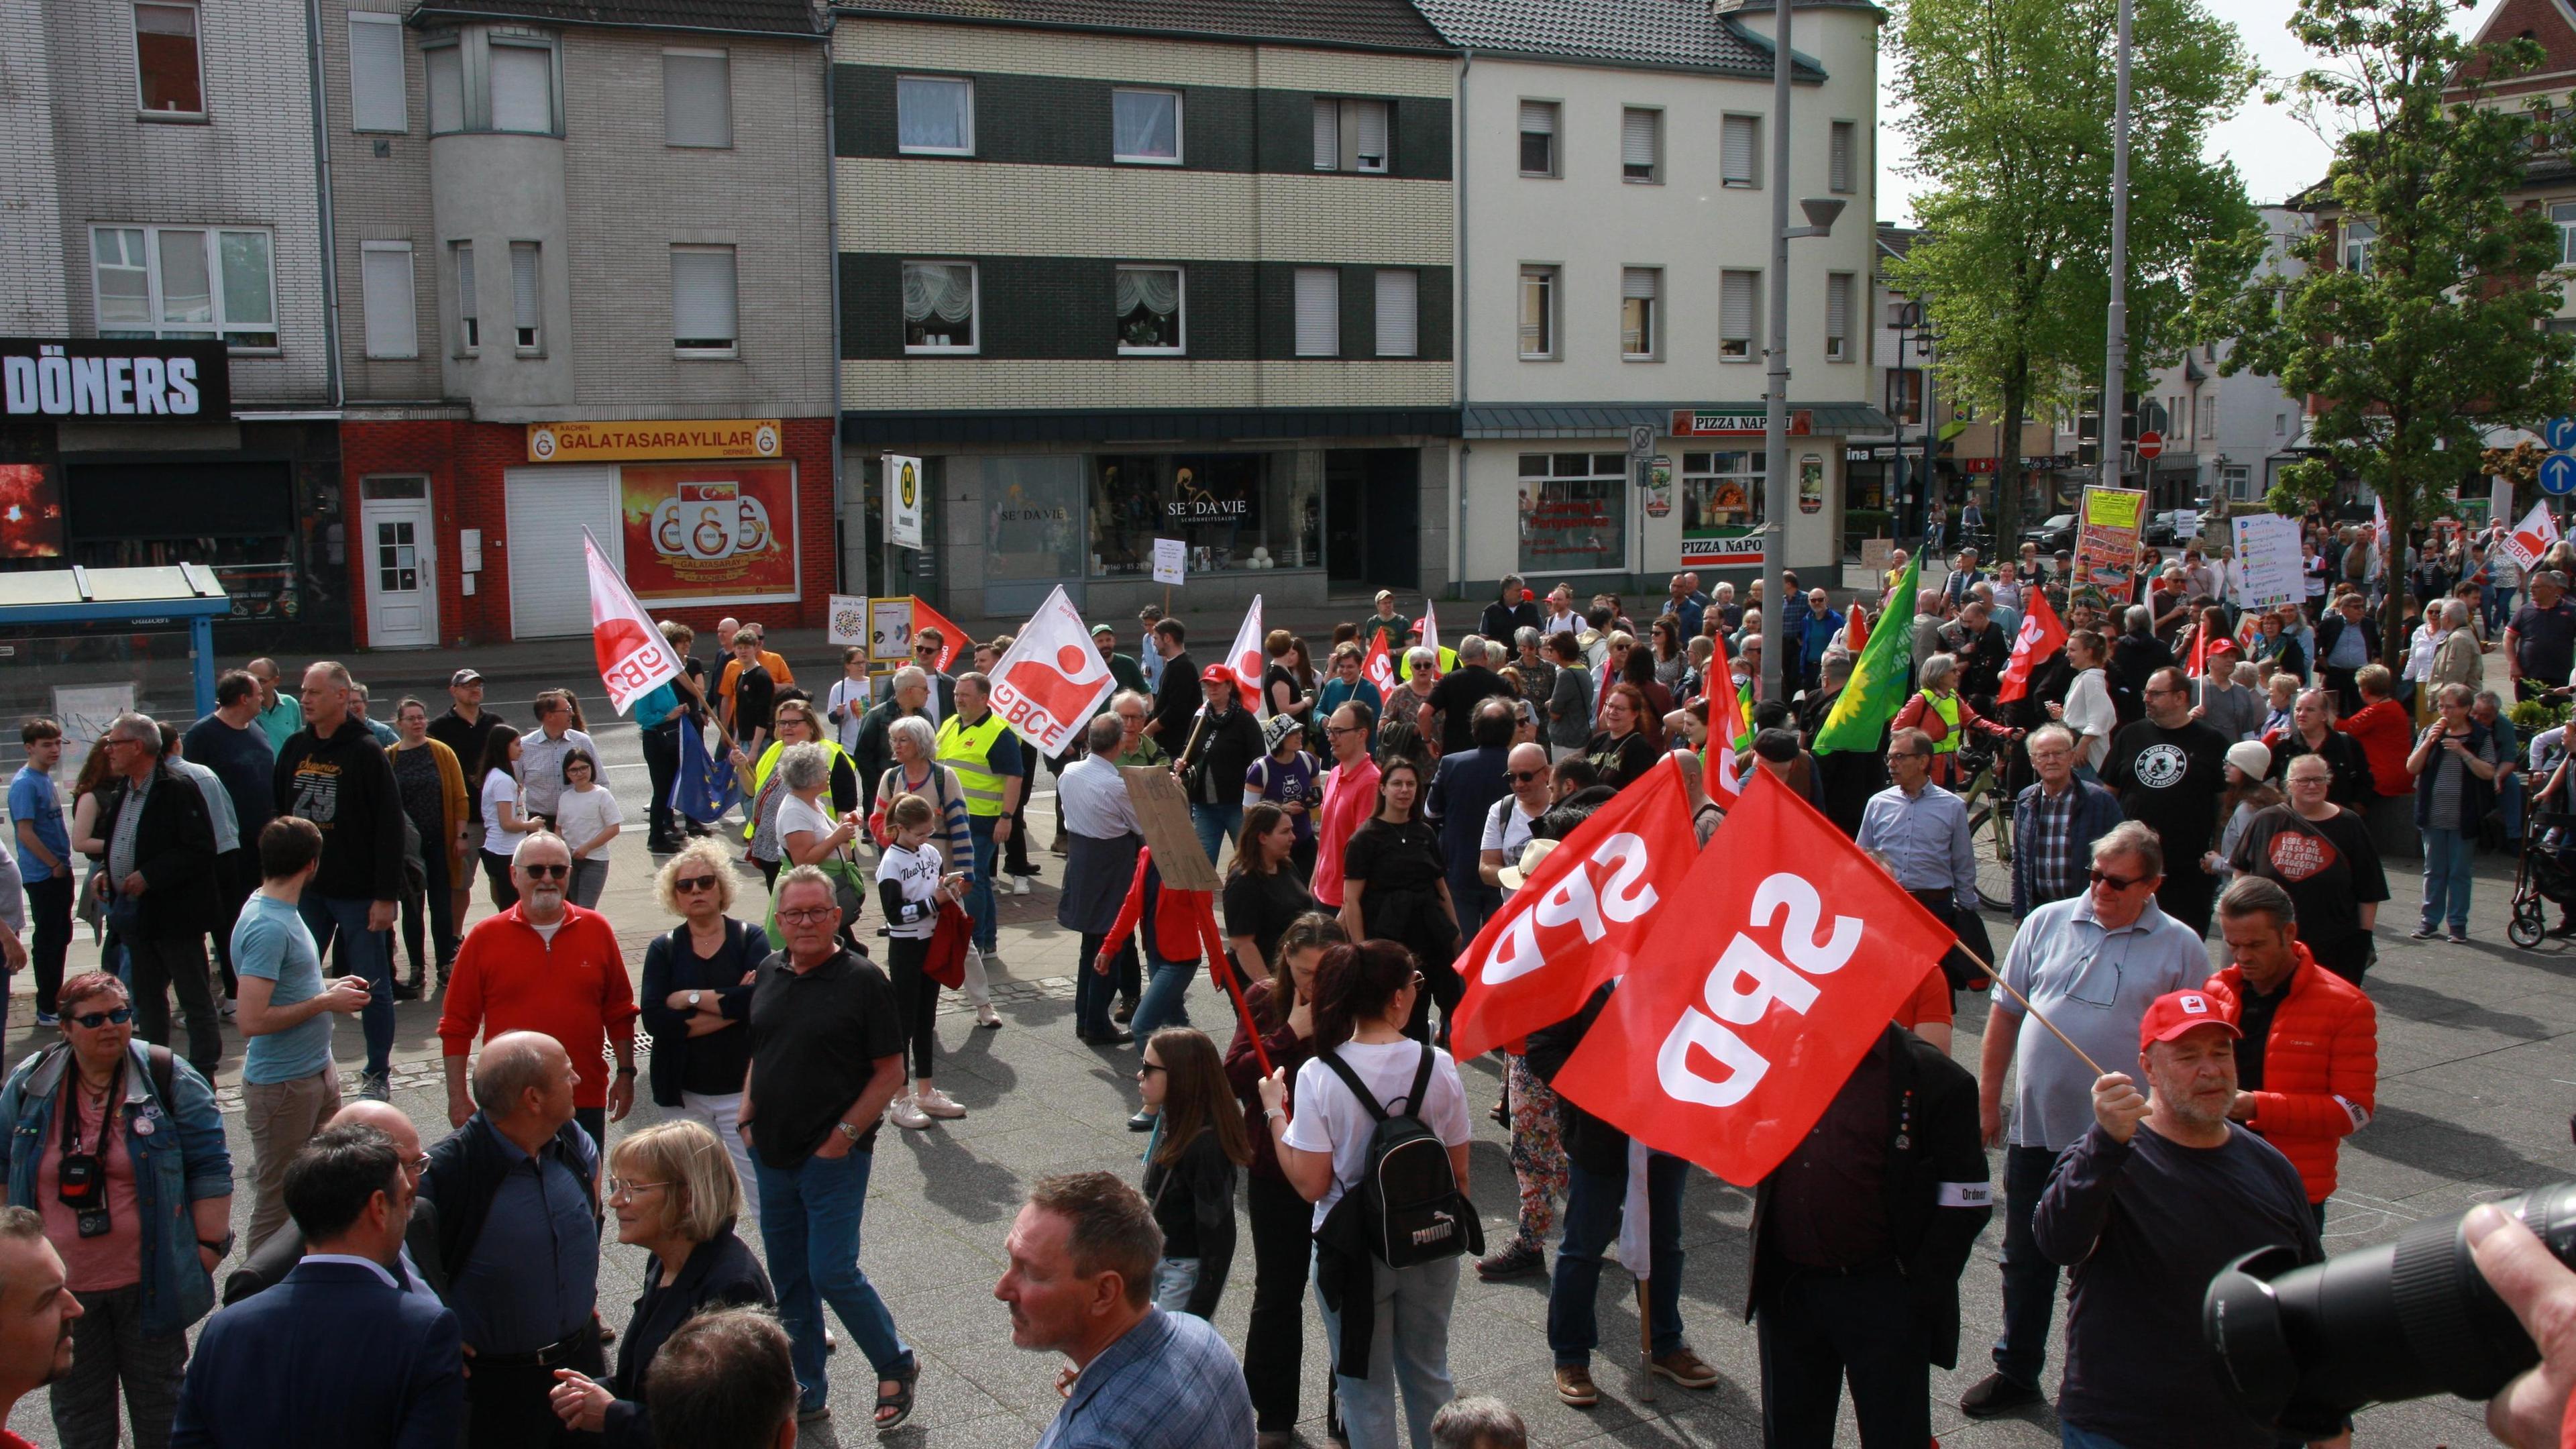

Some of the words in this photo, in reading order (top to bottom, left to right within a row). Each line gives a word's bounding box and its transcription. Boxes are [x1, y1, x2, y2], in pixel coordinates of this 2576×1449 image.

[3, 345, 199, 415] DÖNERS
[1695, 417, 1736, 429] PIZZA
[1739, 417, 1790, 429] NAPI
[559, 431, 753, 449] GALATASARAYLILAR
[1196, 502, 1218, 515] DA
[1221, 500, 1246, 513] VIE
[1537, 500, 1591, 515] Catering
[1594, 498, 1604, 512] &
[1024, 510, 1041, 520] DA
[1042, 509, 1064, 519] VIE
[1181, 515, 1237, 523] SCHÖNHEITSSALON
[1530, 516, 1610, 531] Partyservice
[1681, 541, 1721, 554] PIZZA
[1725, 539, 1765, 553] NAPO
[680, 558, 742, 569] GALATASARAY
[2253, 594, 2290, 606] VIELFALT
[2145, 746, 2163, 756] LOVE
[2139, 768, 2153, 784] HATE
[2153, 769, 2182, 786] FASCISM
[2282, 837, 2302, 845] LEBE
[2282, 844, 2304, 852] DASS
[2306, 846, 2320, 855] DIE
[2277, 857, 2317, 870] DAGEGEN
[2294, 853, 2324, 863] ETWAS
[2284, 866, 2305, 875] HAT!
[1962, 1188, 1987, 1200] Ordner
[1412, 1221, 1452, 1245] PUMA
